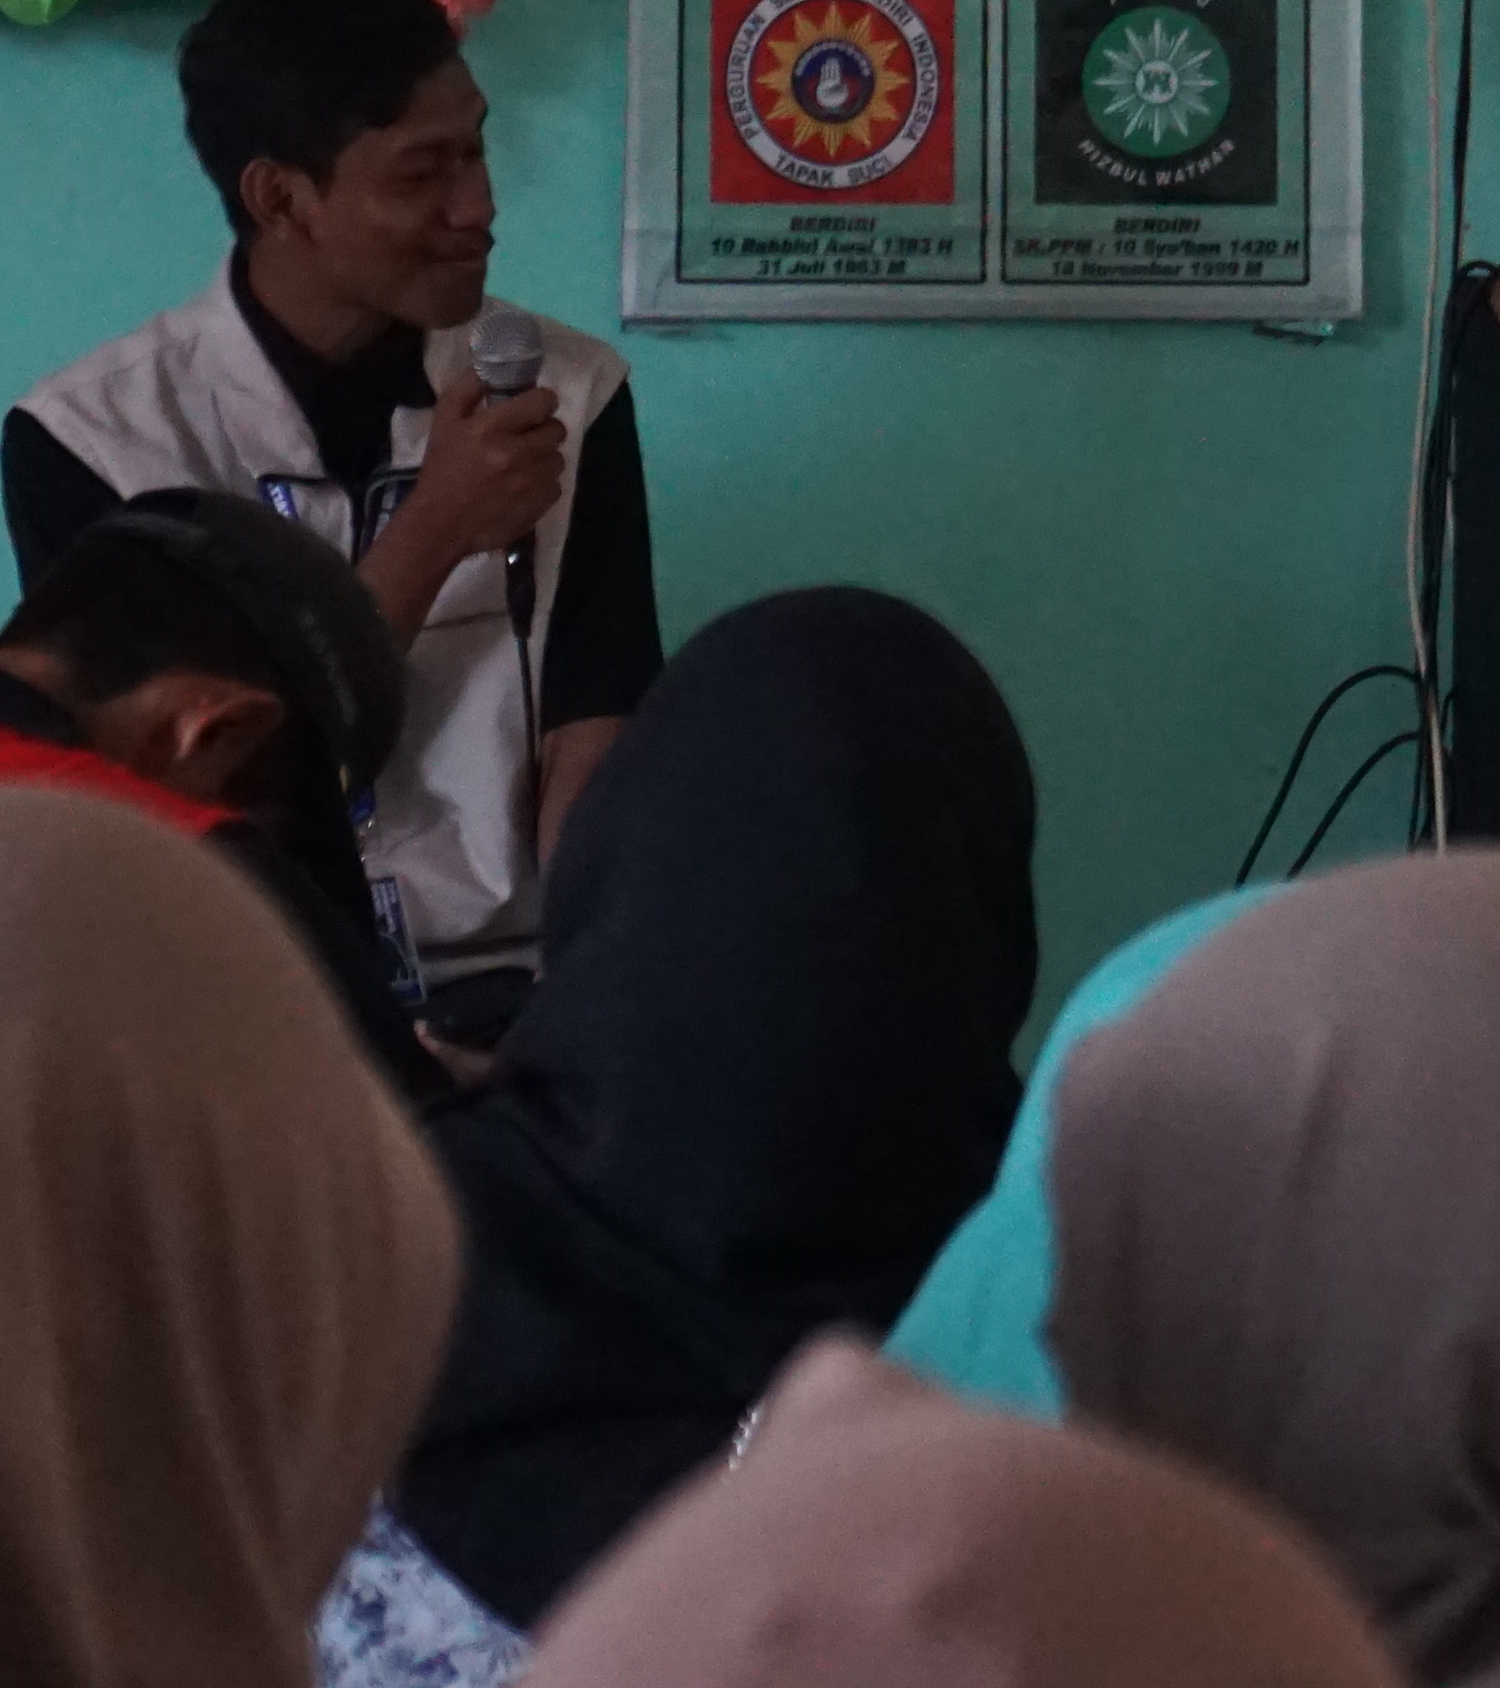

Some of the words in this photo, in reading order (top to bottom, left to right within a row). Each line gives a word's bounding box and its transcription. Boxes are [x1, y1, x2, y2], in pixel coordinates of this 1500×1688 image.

[727, 12, 768, 142] PERGURUAN
[775, 150, 835, 185] TAPAK
[1077, 137, 1148, 187] HIZBUL
[1154, 137, 1236, 187] WATHAN
[789, 216, 877, 232] BERDIRI
[789, 259, 825, 274] Juli
